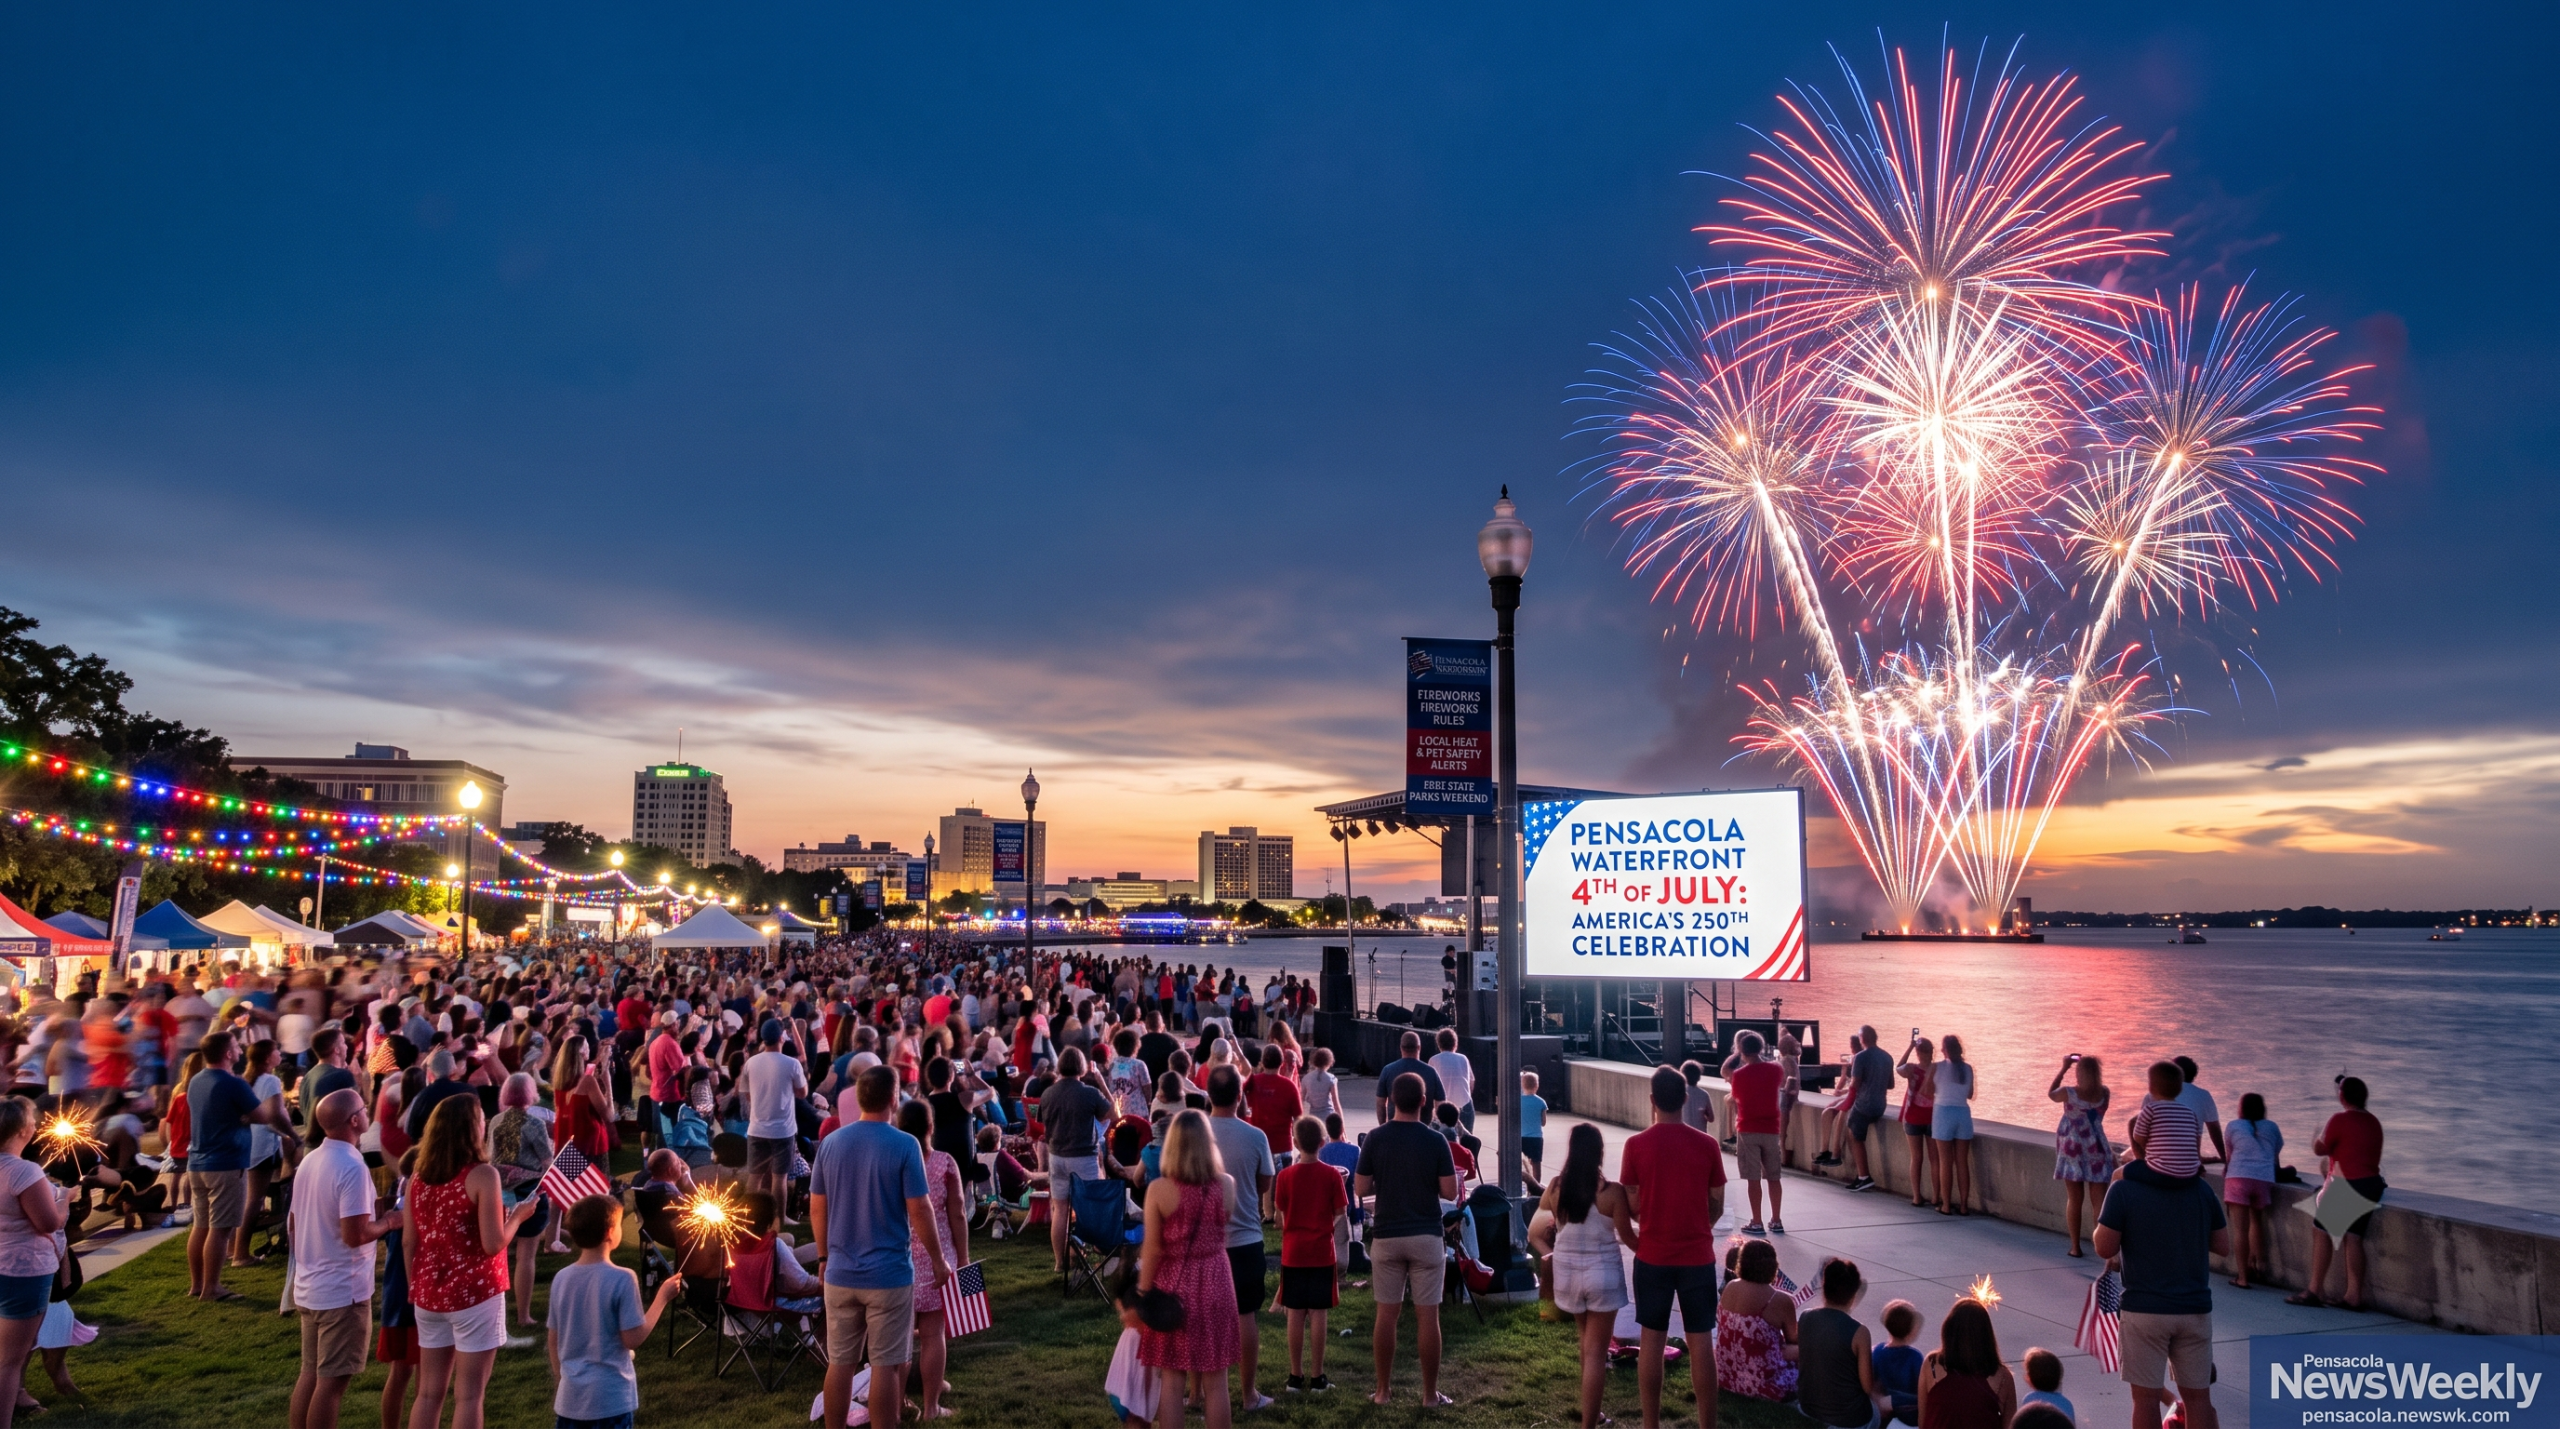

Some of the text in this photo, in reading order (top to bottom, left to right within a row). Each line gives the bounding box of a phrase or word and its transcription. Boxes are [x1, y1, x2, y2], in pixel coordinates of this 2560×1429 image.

[1418, 690, 1481, 702] FIREWORKS
[1420, 702, 1479, 714] FIREWORKS
[1433, 715, 1465, 726] RULES
[1419, 736, 1478, 747] LOCAL HEAT
[1416, 748, 1424, 758] &
[1426, 748, 1444, 758] PET
[1431, 760, 1467, 771] ALERTS
[1447, 781, 1475, 792] STATE
[1409, 792, 1488, 803] PARKS WEEKEND
[1571, 818, 1745, 845] PENSACOLA
[1571, 848, 1746, 872] WATERFRONT
[1572, 876, 1747, 905] 4TH OF JULY:
[1572, 912, 1749, 930] AMERICA'S 250TH
[1572, 936, 1750, 958] CELEBRATION
